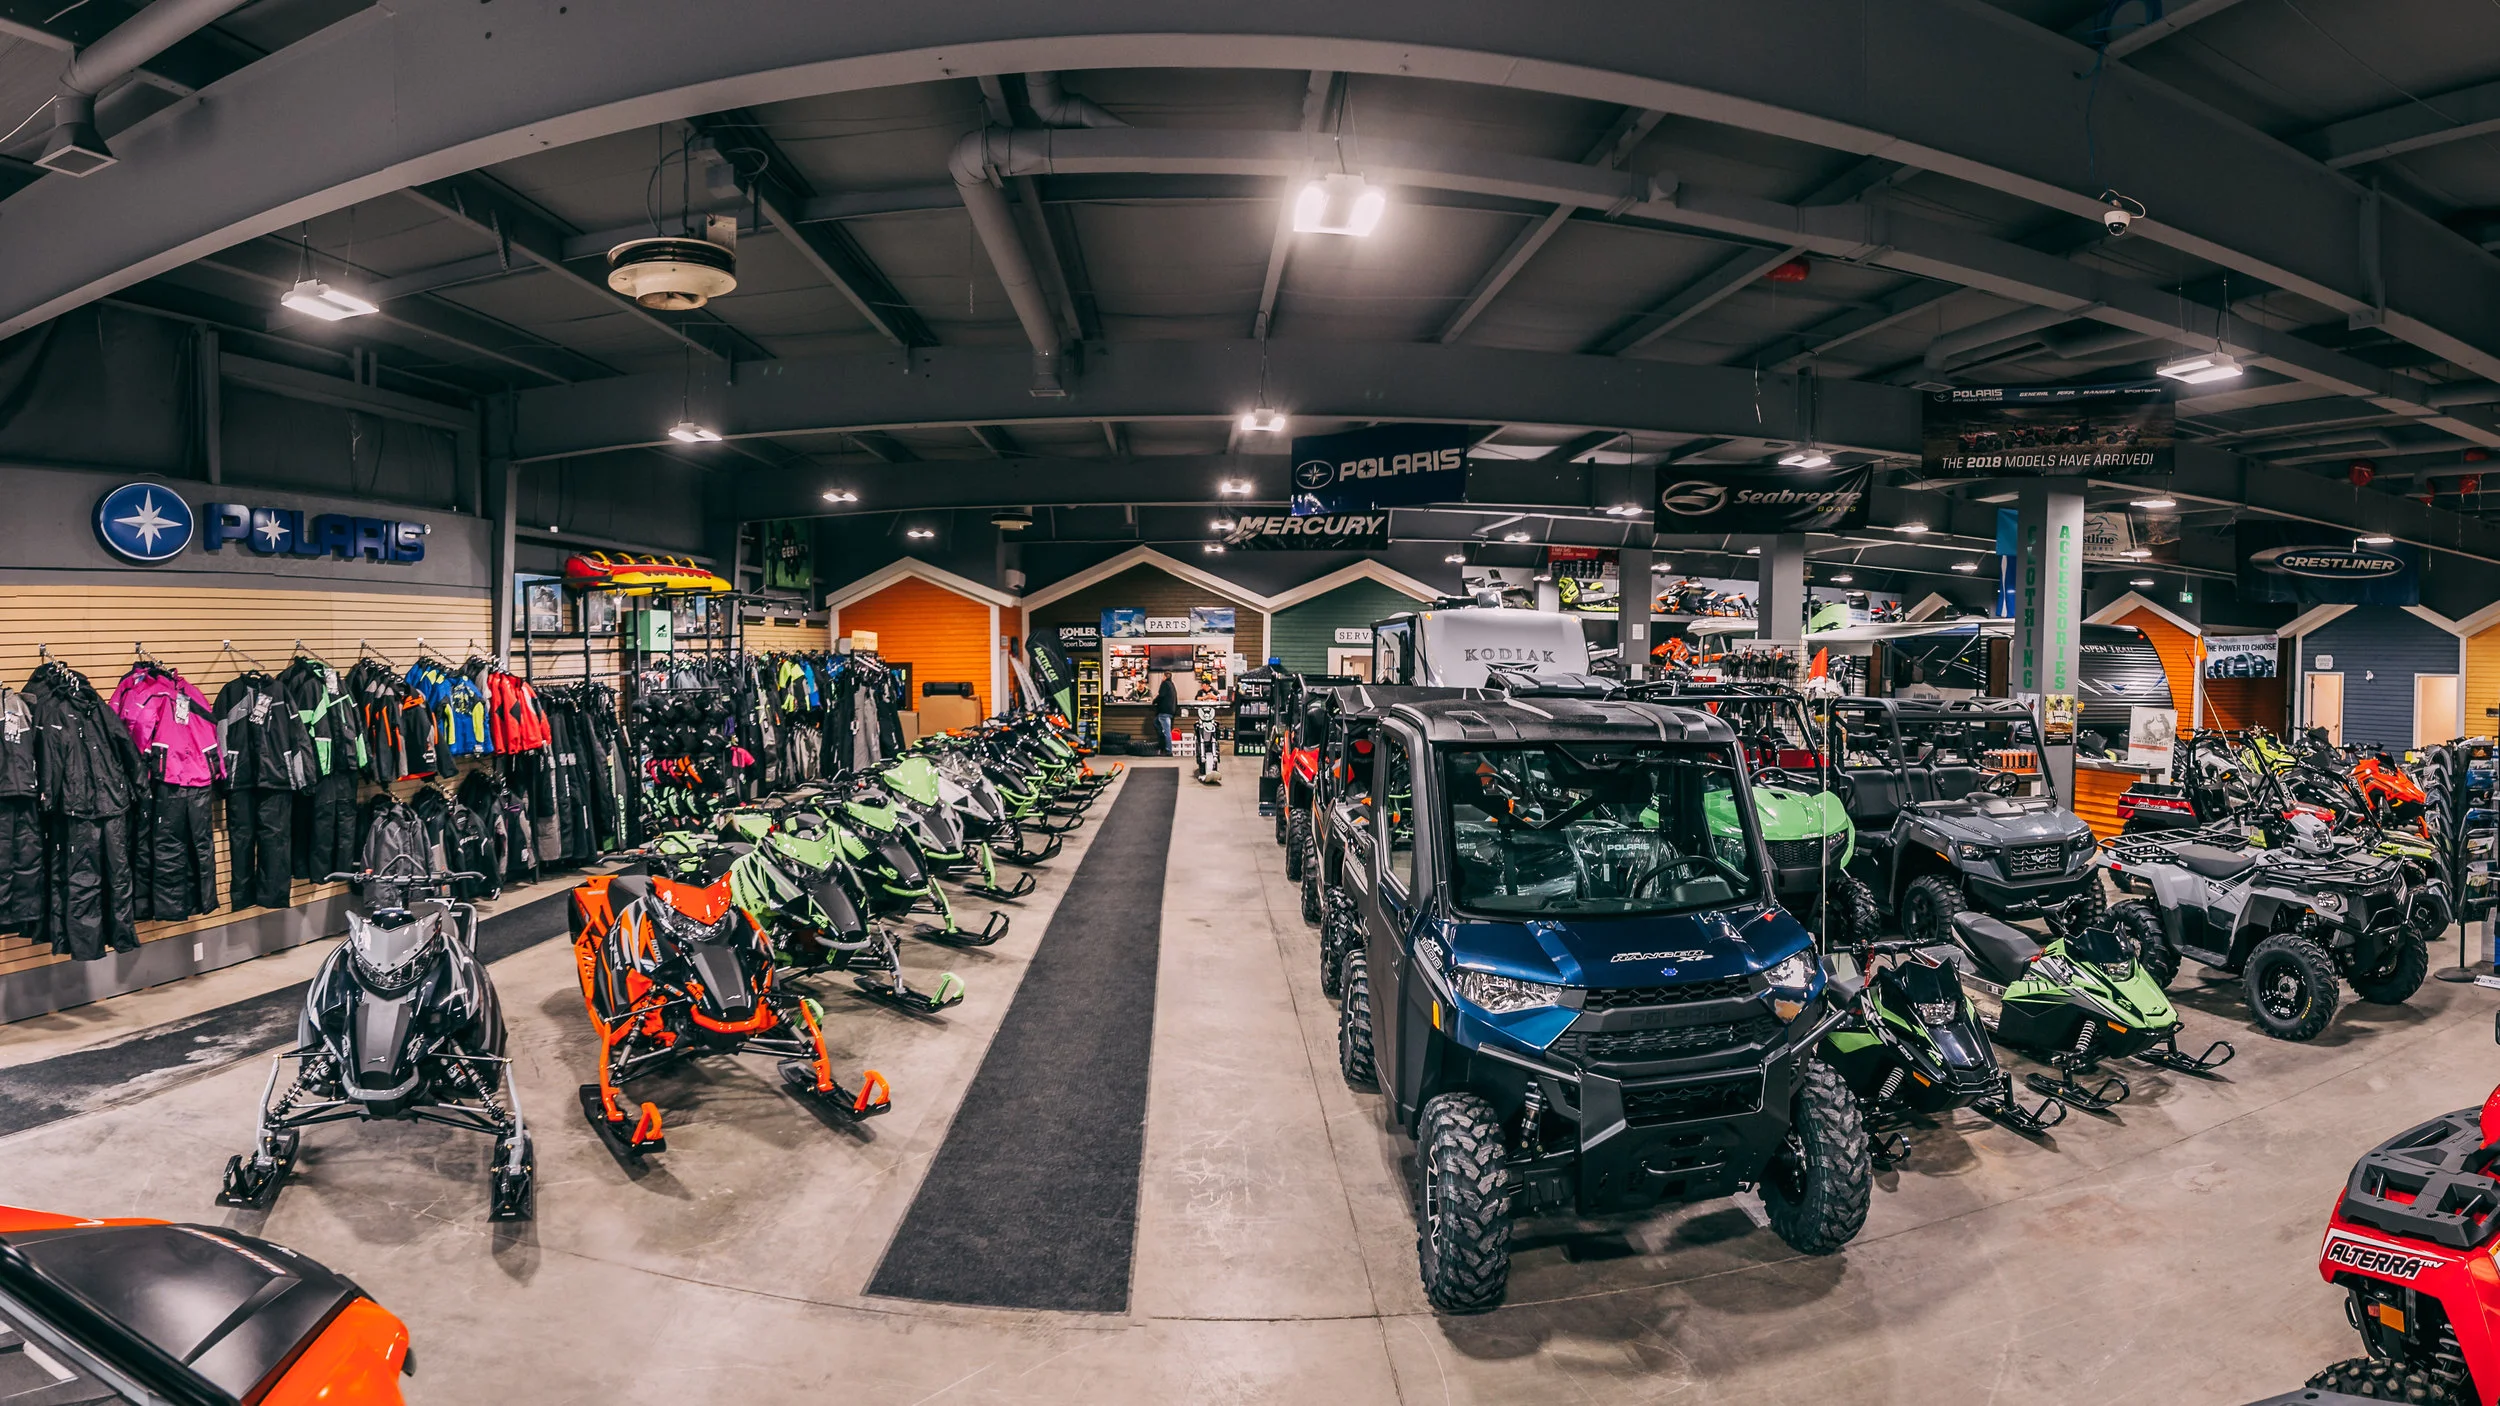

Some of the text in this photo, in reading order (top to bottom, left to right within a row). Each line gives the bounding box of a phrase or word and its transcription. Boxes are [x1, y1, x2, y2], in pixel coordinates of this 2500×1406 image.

[1953, 389, 2003, 398] POLARIS
[1339, 448, 1461, 482] POLARIS
[1942, 453, 2155, 469] THE 2018 MODELS HAVE ARRIVED!
[1733, 489, 1862, 505] Seabreeze
[203, 502, 425, 562] POLARIS
[1236, 516, 1385, 536] MERCURY
[2083, 533, 2115, 545] stline
[2282, 556, 2396, 570] CRESTLINER
[2023, 525, 2038, 689] CLOTHING
[2055, 525, 2071, 690] ACCESSORIES
[1059, 627, 1098, 637] KOHLER
[1150, 620, 1187, 629] PARTS
[1079, 639, 1097, 648] Dealer
[2218, 644, 2241, 652] POWER
[2251, 642, 2276, 651] CHOOSE
[1464, 648, 1556, 663] KODIAK
[1034, 647, 1052, 671] ARCTIC
[1047, 669, 1059, 681] CAT
[1610, 949, 1705, 963] RANGER
[1676, 954, 1714, 963] XP
[2327, 1241, 2423, 1281] ALTERRA
